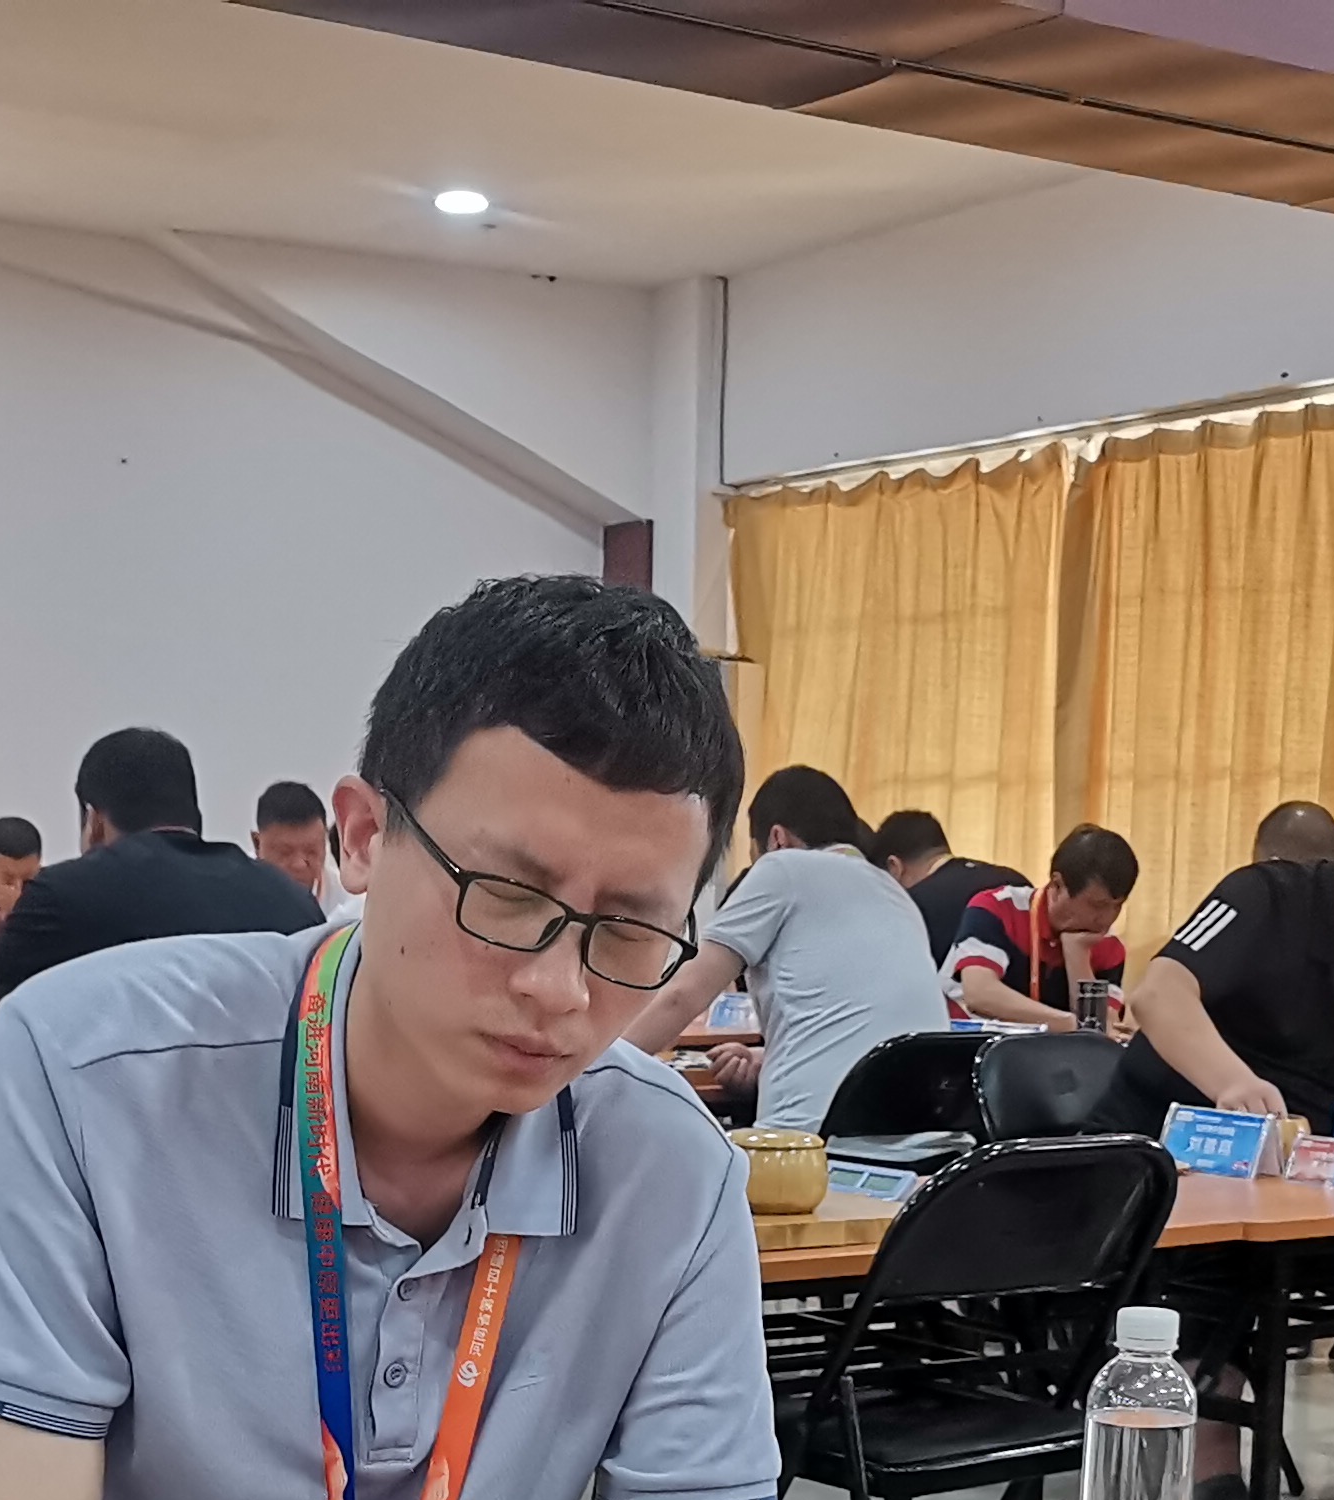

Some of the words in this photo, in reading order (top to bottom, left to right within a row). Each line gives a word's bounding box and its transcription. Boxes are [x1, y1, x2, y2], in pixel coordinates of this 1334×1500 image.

[305, 991, 332, 1177] 奋进河南新时代
[469, 1232, 509, 1357] 河南省第十四届运
